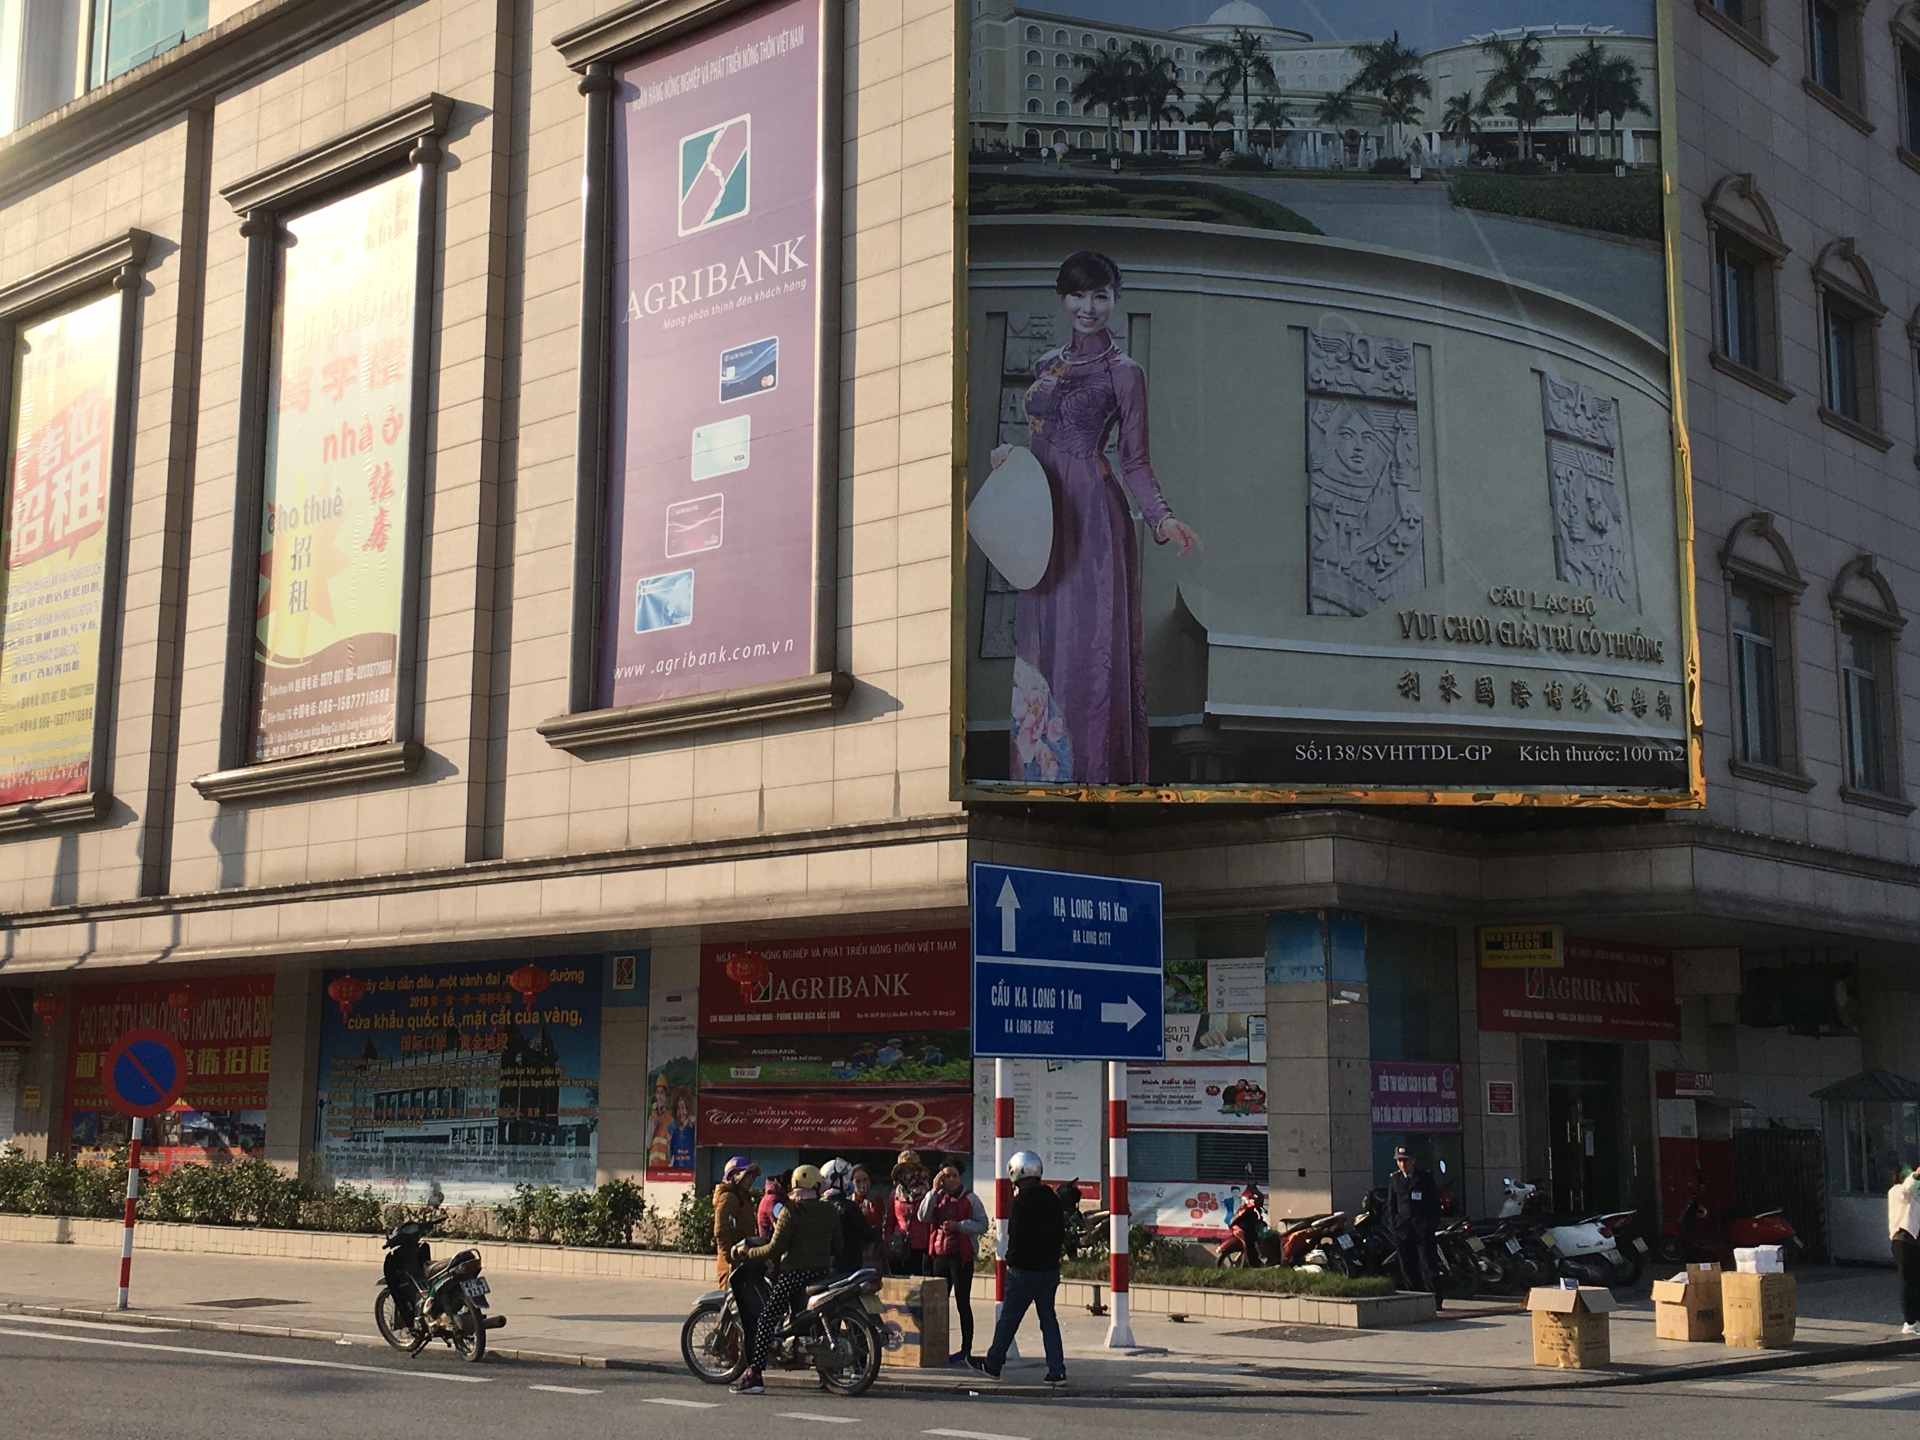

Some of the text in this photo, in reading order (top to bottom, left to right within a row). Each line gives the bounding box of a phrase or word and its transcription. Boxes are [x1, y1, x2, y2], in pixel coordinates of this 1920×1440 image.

[649, 82, 664, 102] HÀNG
[664, 75, 680, 98] NÔNG
[680, 65, 700, 93] NGHIỆP
[701, 61, 710, 85] VÀ
[710, 55, 725, 82] PHÁT
[726, 45, 742, 75] TRIỂN
[743, 43, 759, 69] NÔNG
[760, 34, 776, 62] THÔN
[776, 28, 789, 57] VIỆT
[790, 24, 804, 50] NAM
[621, 234, 809, 323] AGRIBANK
[662, 315, 686, 330] Mang
[754, 284, 781, 302] khách
[784, 278, 807, 291] hàng
[323, 411, 375, 464] nhà
[11, 441, 103, 556] 招租
[303, 486, 344, 526] thuê
[288, 535, 312, 615] 招租
[1531, 590, 1569, 615] LẠC
[1572, 594, 1597, 621] BỘ
[1398, 608, 1438, 639] VUI
[1443, 614, 1493, 645] CHƠI
[1543, 622, 1576, 652] TRÍ
[1578, 623, 1602, 654] CÓ
[1294, 739, 1685, 763] Số:138/SVHTTDL-GP Kích thước:100 m2
[1053, 896, 1128, 923] HẠ LONG 161 Km
[783, 948, 808, 959] NGHIỆP
[811, 946, 821, 957] VÀ
[822, 945, 843, 957] PHÁT
[846, 942, 867, 956] TRIỂN
[869, 943, 891, 955] NÔNG
[894, 941, 915, 953] THÔN
[917, 940, 935, 954] VIỆT
[937, 940, 957, 951] NAM
[1072, 929, 1112, 946] HA LONG CITY
[1485, 931, 1541, 942] WESTERN
[1503, 941, 1541, 950] UNION
[774, 973, 911, 1001] AGRIBANK
[991, 979, 1082, 1010] CẦU KA LONG 1 Km
[1546, 976, 1642, 1005] AGRIBANK
[374, 1009, 404, 1029] khẩu
[407, 1008, 439, 1032] quốc
[1004, 1019, 1054, 1035] KA LONG BRIDGE
[401, 1032, 509, 1052] 国际口岸 黄金地段
[1694, 1074, 1713, 1089] ATM
[705, 1108, 747, 1125] Chúc
[794, 1115, 824, 1125] năm
